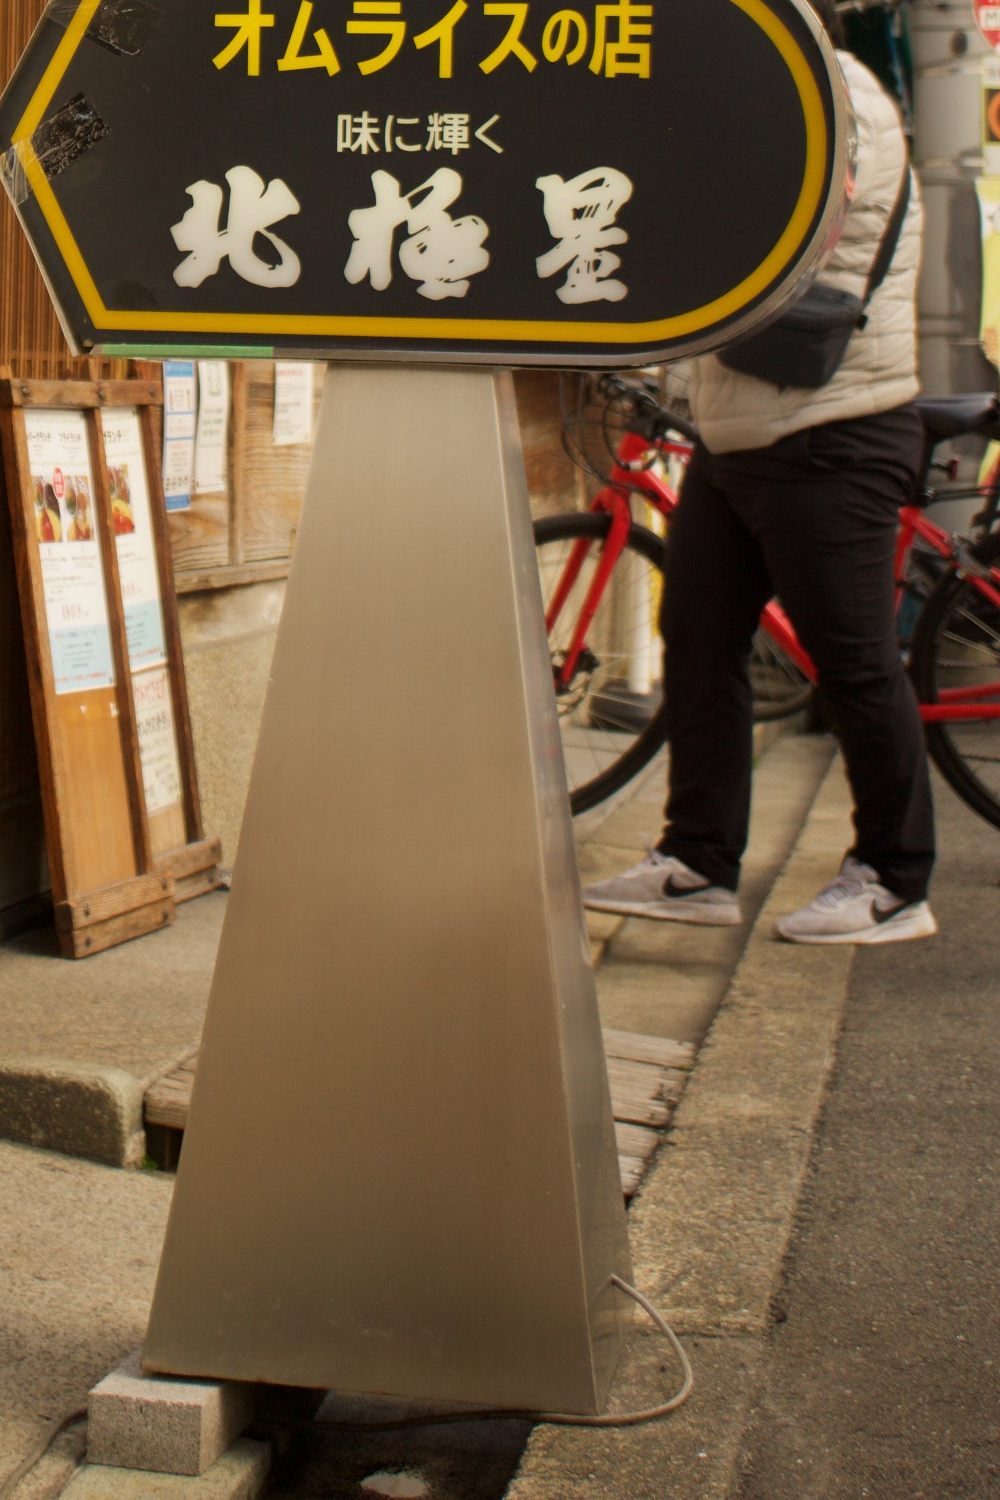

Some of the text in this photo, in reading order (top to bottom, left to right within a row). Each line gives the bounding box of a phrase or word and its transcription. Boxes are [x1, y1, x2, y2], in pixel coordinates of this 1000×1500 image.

[336, 112, 504, 155] 味に輝く
[171, 165, 634, 305] 北極星
